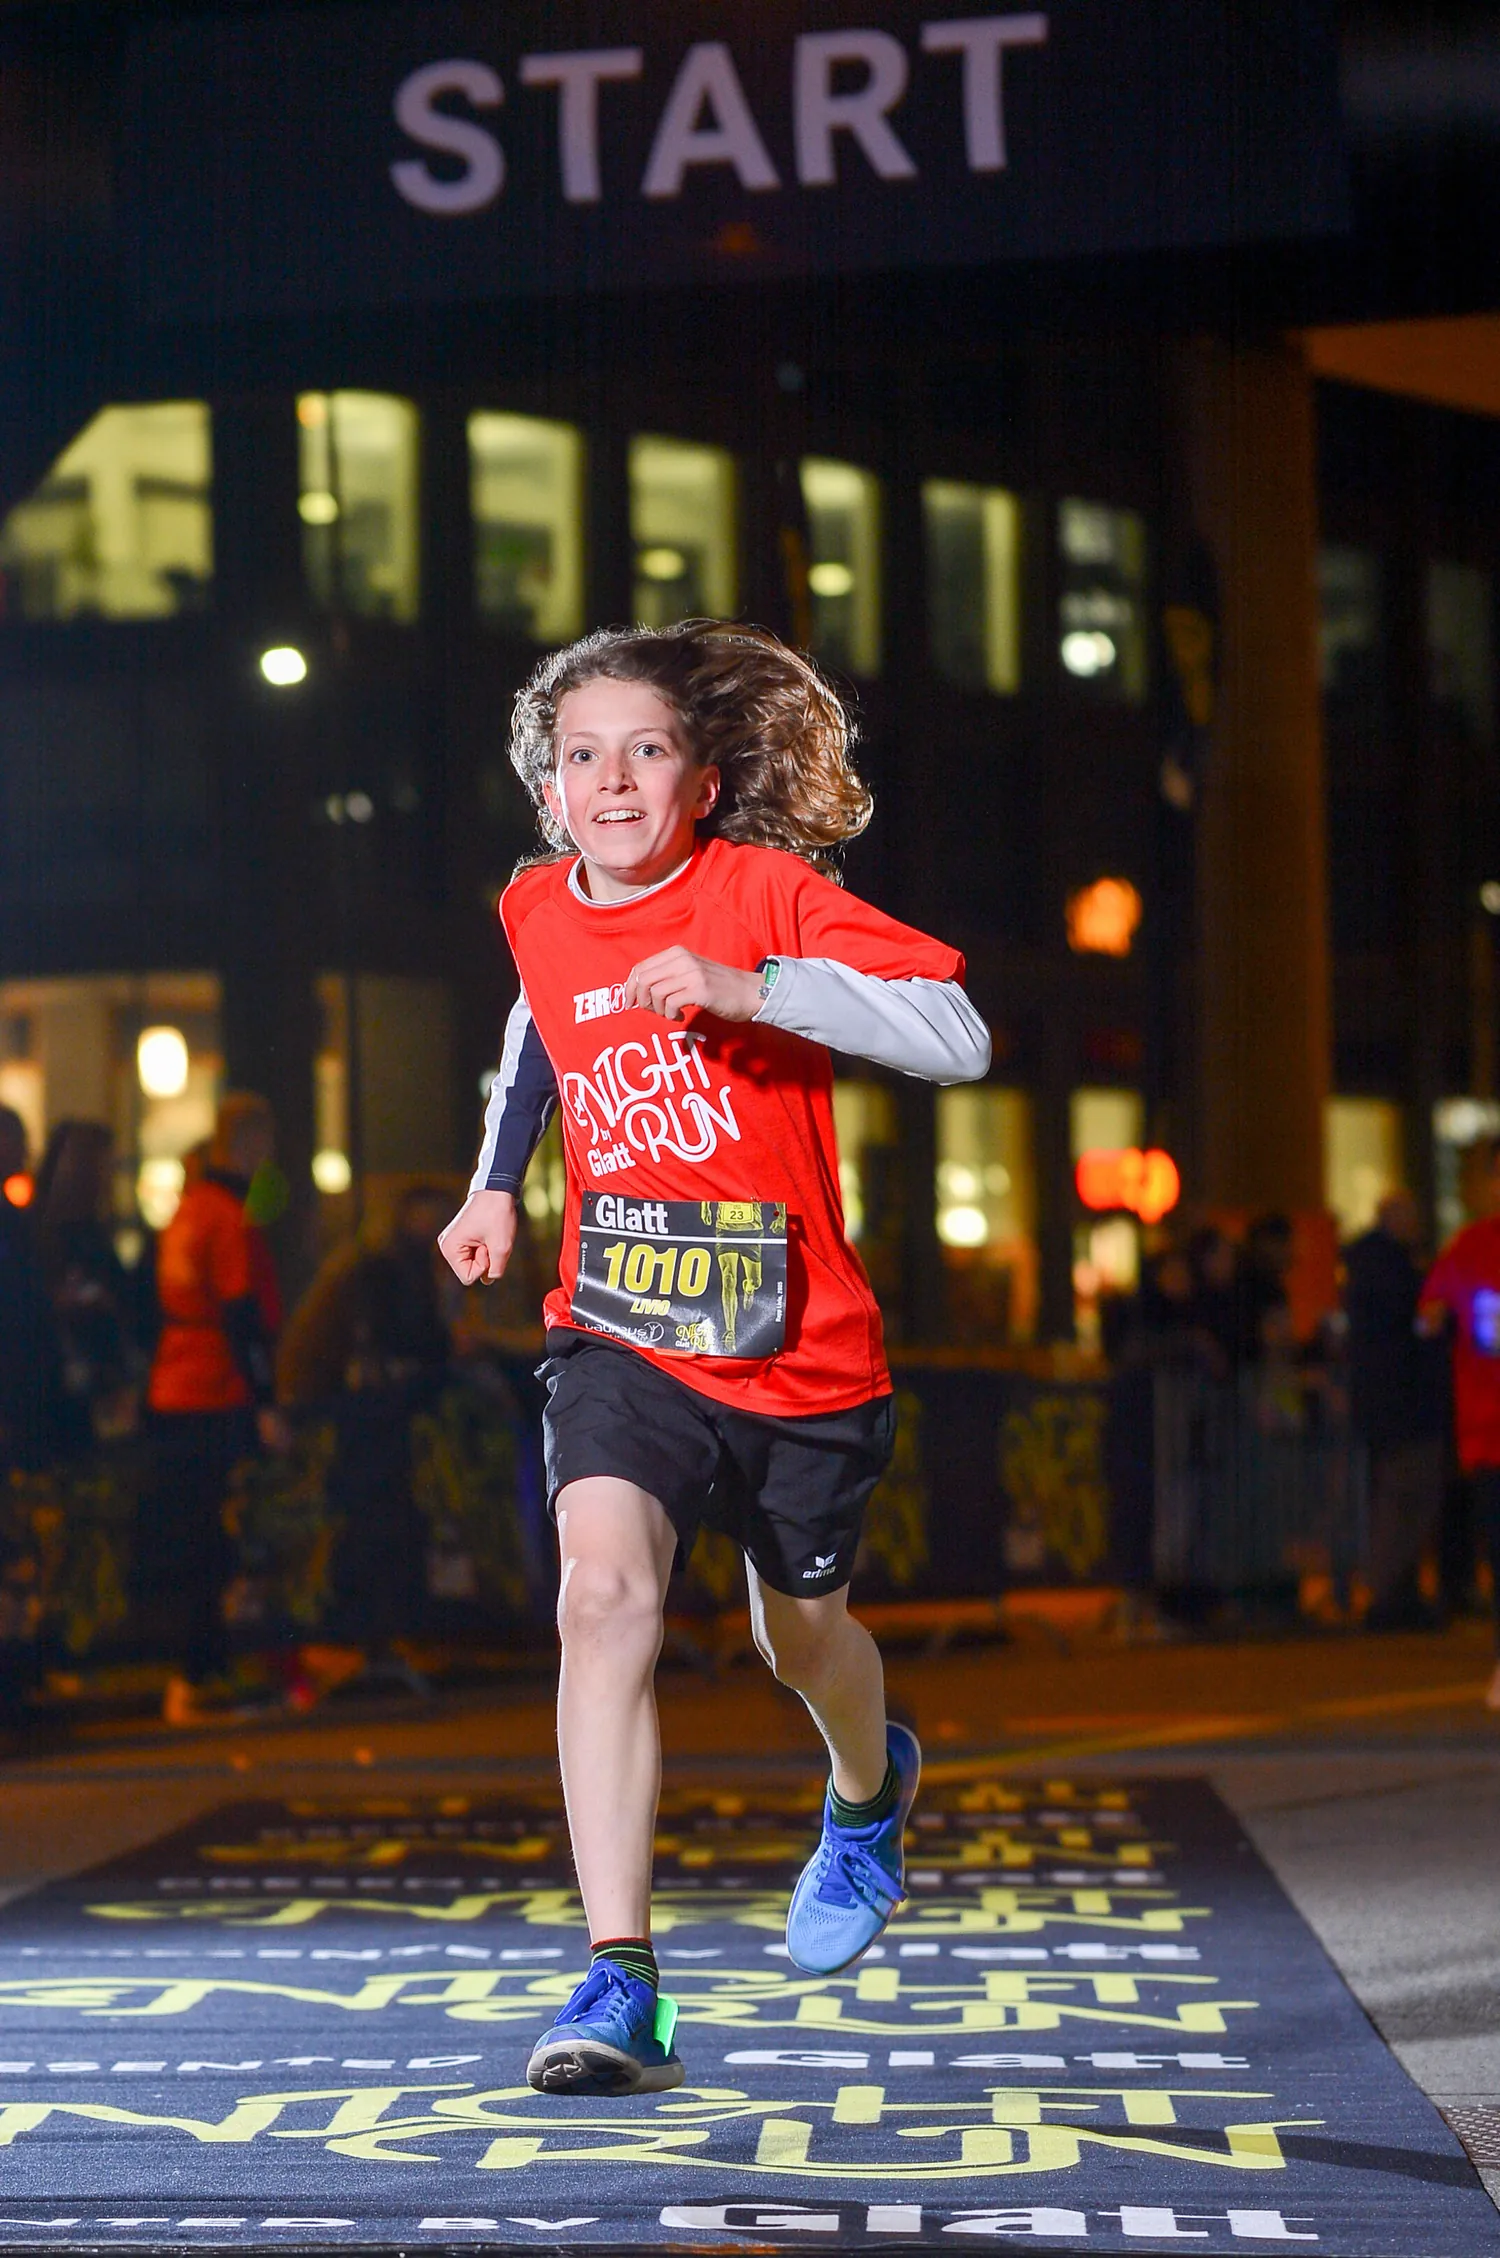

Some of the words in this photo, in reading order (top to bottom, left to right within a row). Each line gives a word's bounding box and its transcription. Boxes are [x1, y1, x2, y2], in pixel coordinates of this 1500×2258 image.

[390, 13, 1048, 216] START
[563, 1031, 711, 1145] NIGHT
[625, 1085, 741, 1163] RUN
[587, 1142, 636, 1177] Glatt
[595, 1195, 669, 1234] Glatt
[730, 1210, 744, 1220] 23
[603, 1241, 711, 1297] 1010
[630, 1298, 671, 1316] LIVIO
[802, 1566, 836, 1579] erima
[723, 2050, 1250, 2069] Glatt
[325, 2119, 1326, 2179] RUN
[417, 2217, 601, 2230] BY
[659, 2206, 1319, 2240] Glatt
